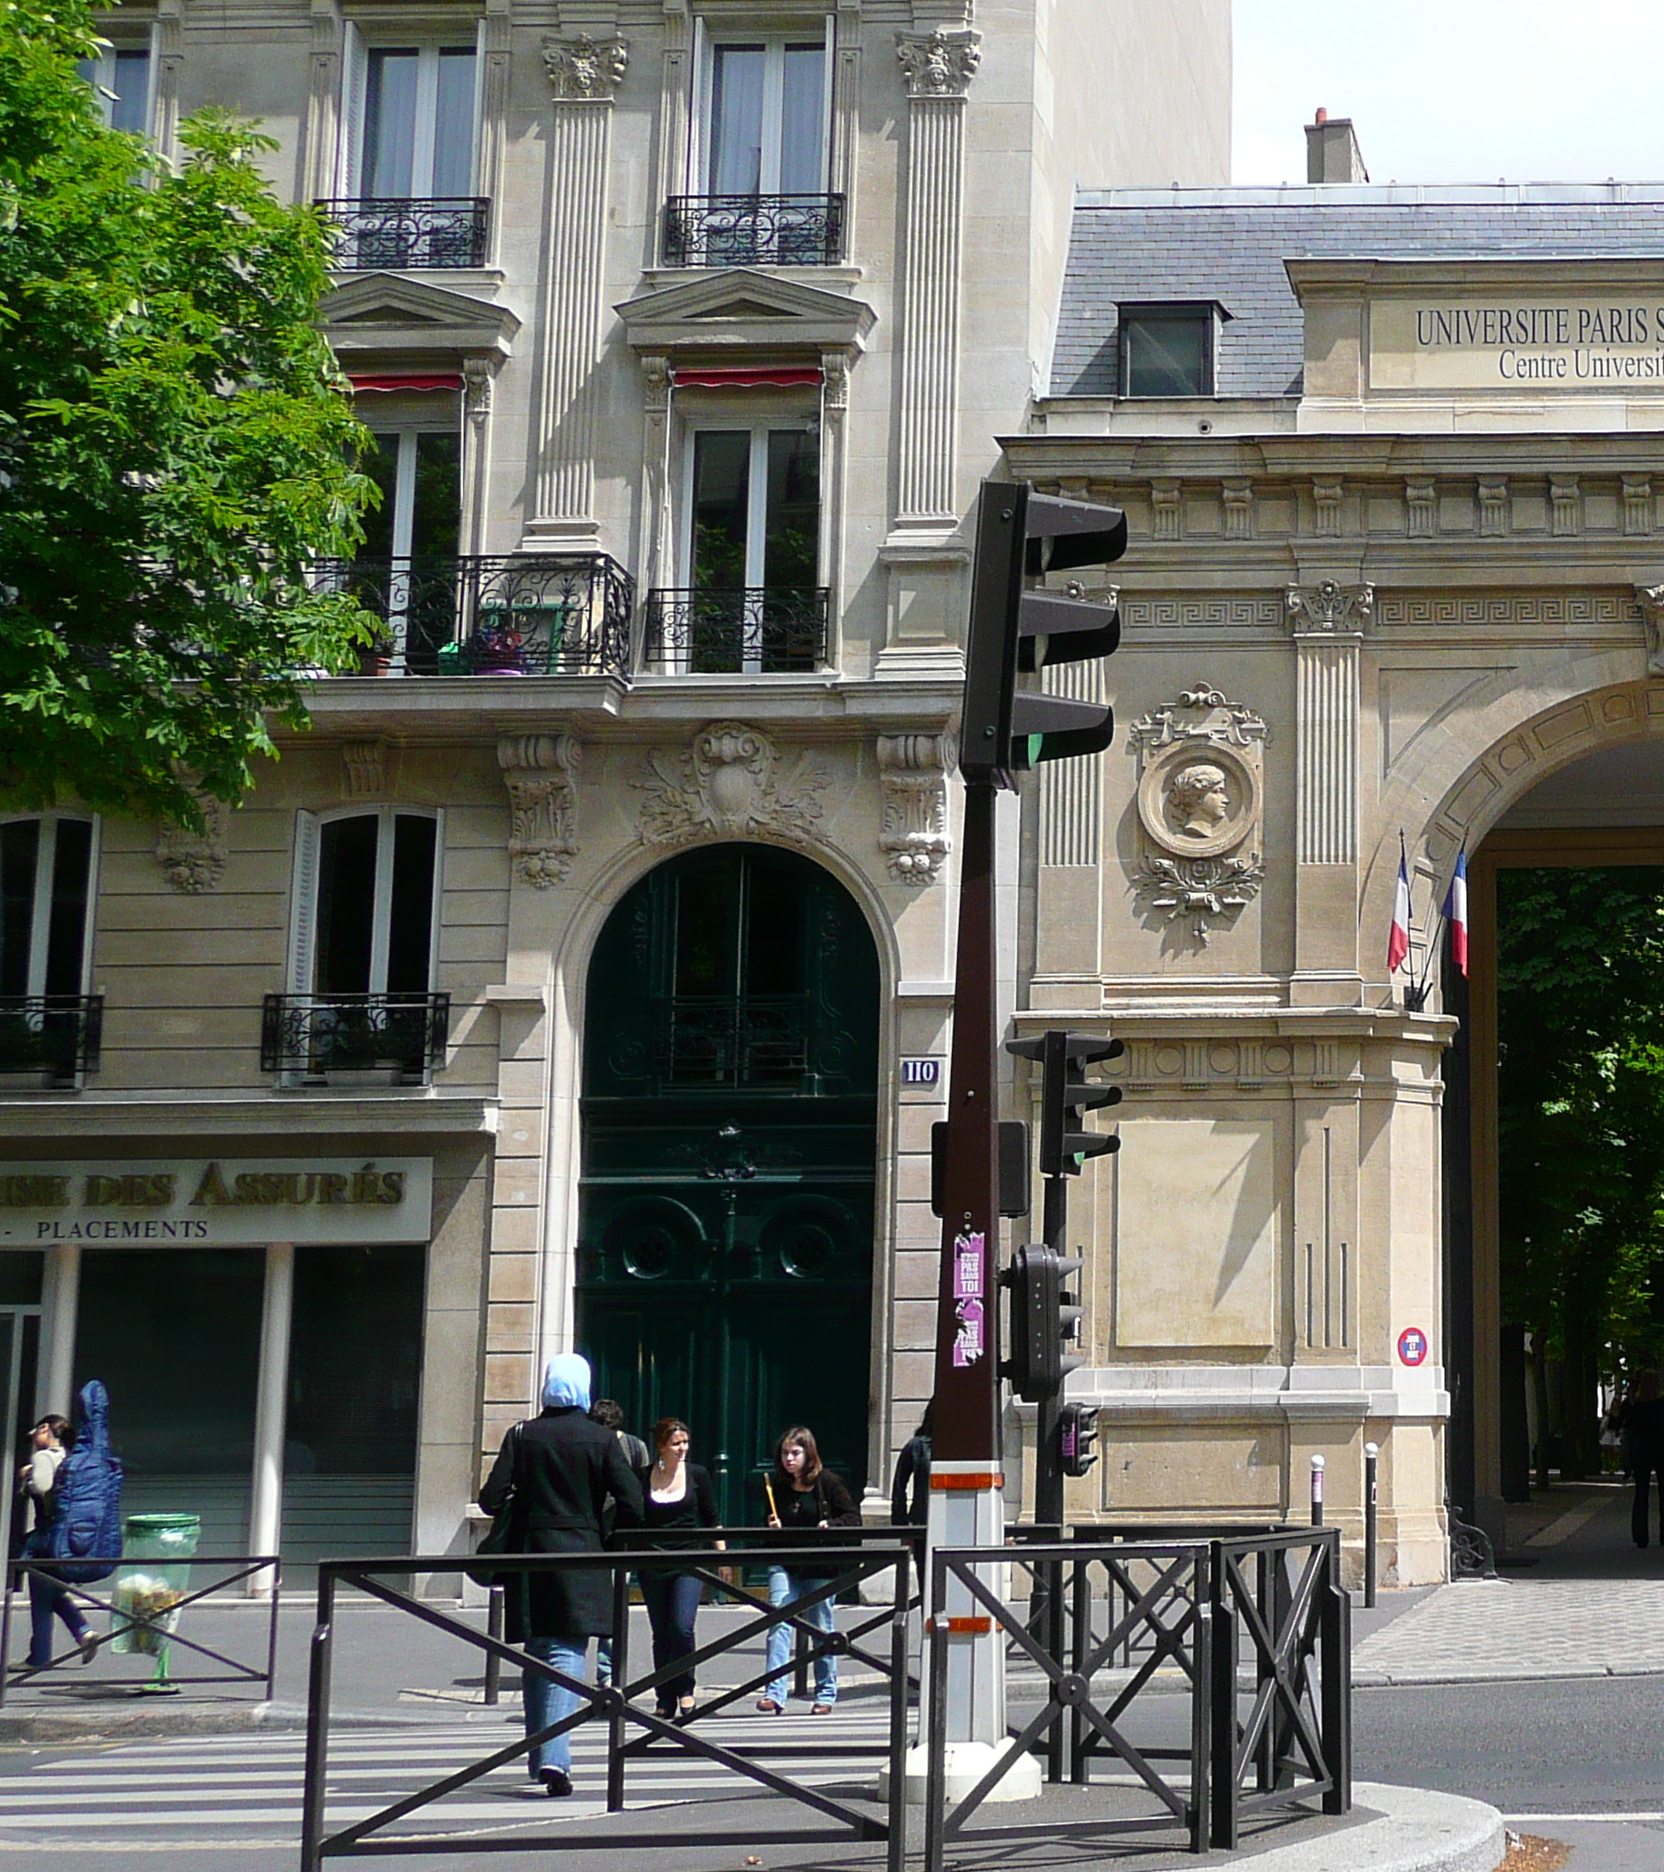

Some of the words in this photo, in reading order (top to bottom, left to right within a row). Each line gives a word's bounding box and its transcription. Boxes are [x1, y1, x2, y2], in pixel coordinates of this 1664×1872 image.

[1416, 308, 1570, 346] UNIVERSITE
[1577, 307, 1648, 344] PARIS
[1499, 349, 1567, 379] Centre
[907, 1062, 934, 1081] 110
[82, 1173, 177, 1207] DES
[37, 1221, 208, 1239] PLACEMENTS
[960, 1280, 979, 1293] TOI
